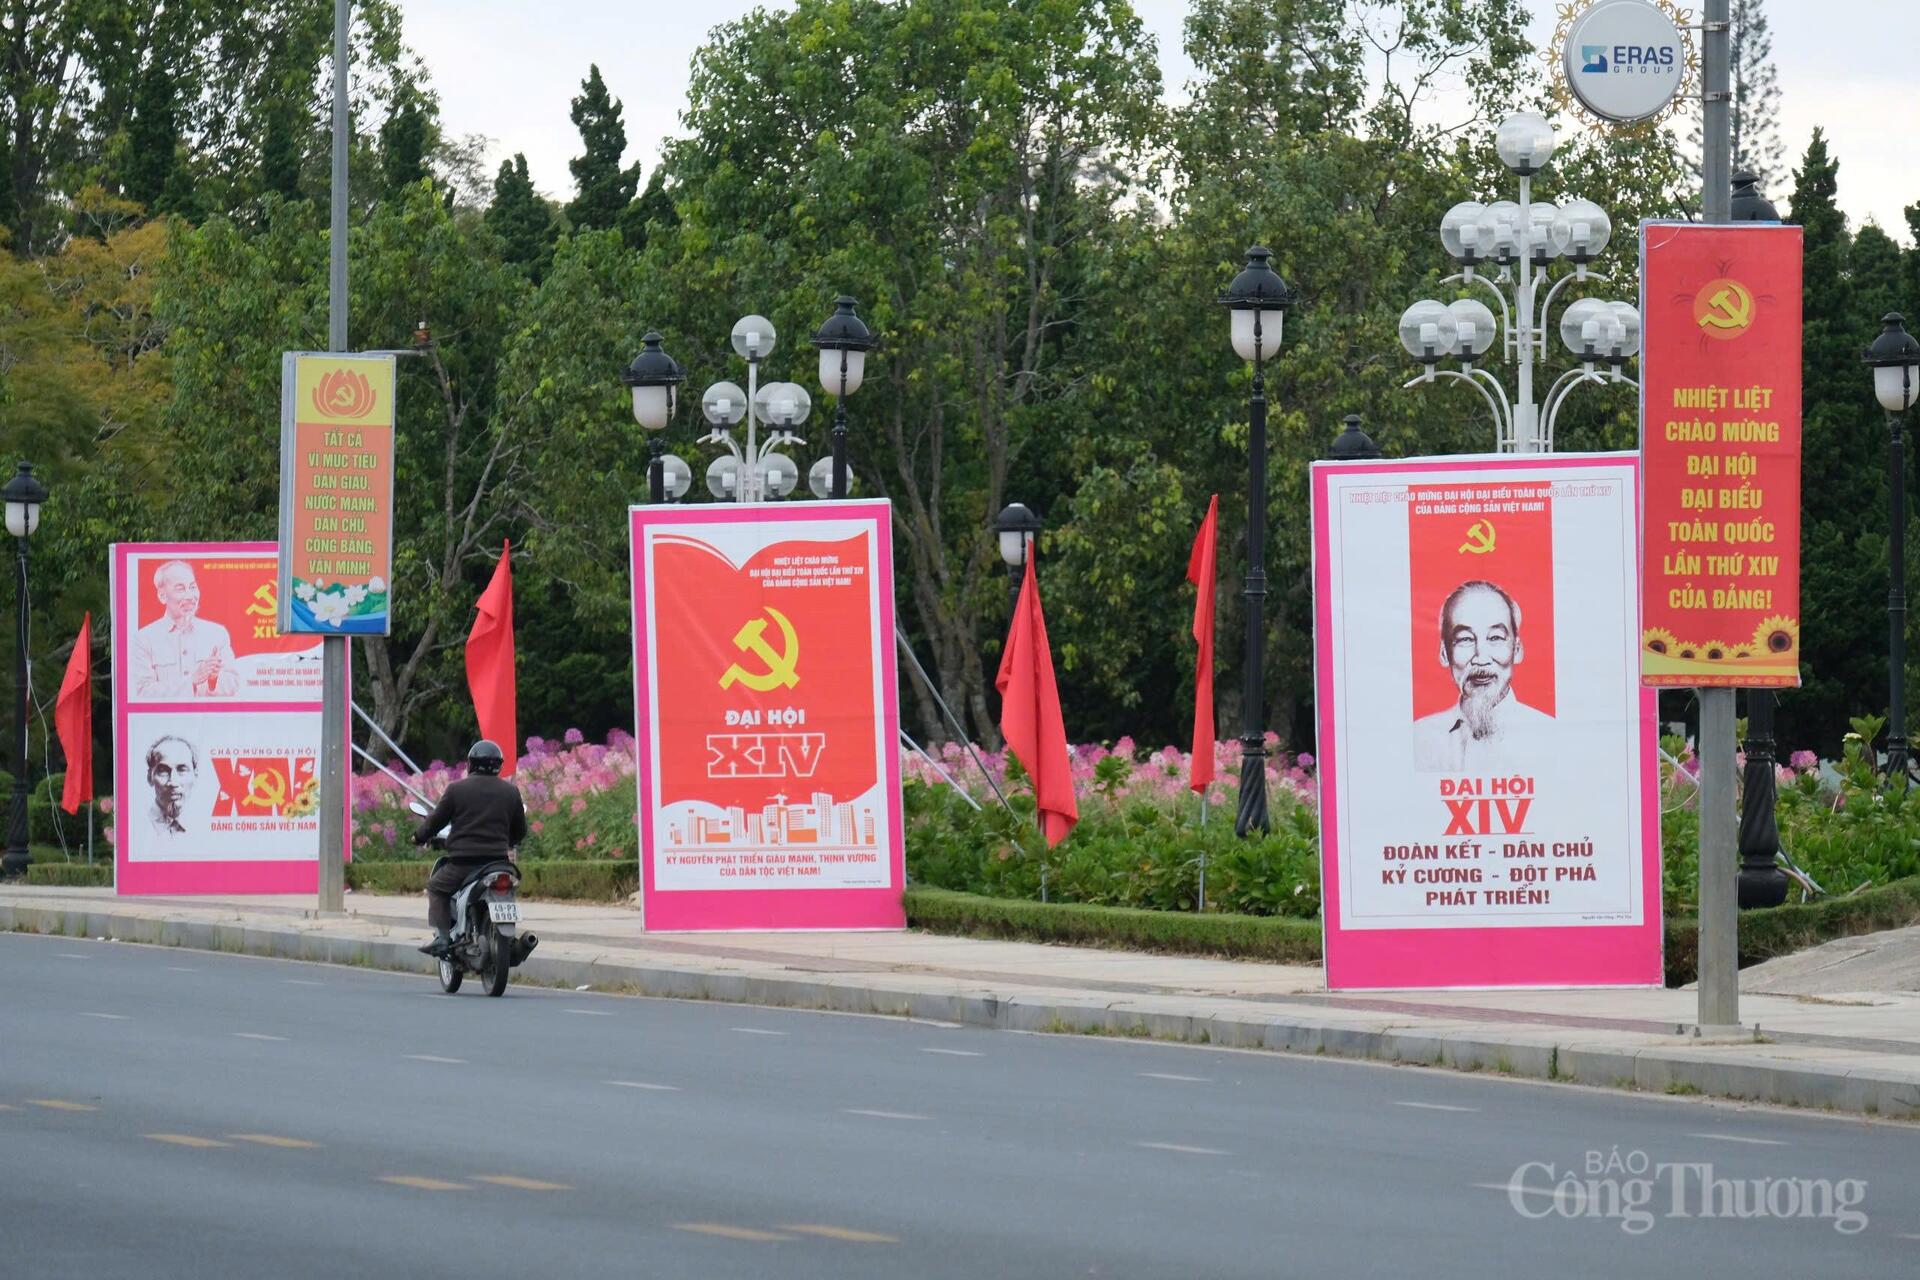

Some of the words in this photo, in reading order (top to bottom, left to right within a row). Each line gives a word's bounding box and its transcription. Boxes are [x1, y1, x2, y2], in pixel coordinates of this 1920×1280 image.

[1613, 46, 1673, 64] ERAS
[1613, 66, 1673, 74] GROUP
[1673, 384, 1729, 413] NHIỆT
[1734, 384, 1773, 413] LIỆT
[323, 429, 344, 447] TẤT
[347, 429, 362, 448] CẢ
[1665, 417, 1717, 441] CHÀO
[1722, 417, 1780, 442] MỪNG
[308, 450, 319, 467] VÌ
[323, 453, 348, 471] MỤC
[352, 451, 377, 469] TIÊU
[1687, 455, 1719, 480] ĐẠI
[1725, 451, 1757, 480] HỘI
[313, 473, 337, 489] DÂN
[305, 493, 336, 510] NƯỚC
[1350, 491, 1372, 504] NHIỆT
[1374, 490, 1393, 504] LIỆT
[1417, 488, 1442, 501] MỪNG
[1444, 490, 1459, 503] ĐẠI
[1460, 487, 1475, 502] HỘI
[1476, 489, 1491, 501] ĐẠI
[1492, 485, 1511, 499] BIỂU
[1513, 487, 1535, 499] TOÀN
[1537, 485, 1560, 499] QUỐC
[1598, 486, 1614, 497] XIV
[1681, 488, 1713, 513] ĐẠI
[1719, 480, 1762, 509] BIỂU
[1415, 501, 1432, 514] CỦA
[1434, 501, 1457, 514] ĐẢNG
[1459, 502, 1481, 515] CỘNG
[1483, 499, 1501, 513] SẢN
[1502, 501, 1520, 514] VIỆT
[1521, 502, 1545, 512] NAM!
[314, 515, 338, 531] DÂN
[1668, 517, 1719, 542] TOÀN
[1723, 515, 1775, 544] QUỐC
[305, 536, 337, 553] CÔNG
[335, 560, 370, 575] MINH!
[1663, 548, 1701, 575] LẦN
[1706, 551, 1745, 576] THỨ
[1748, 555, 1779, 576] XIV
[1669, 582, 1708, 609] CỦA
[1712, 582, 1772, 609] ĐẢNG!
[725, 709, 761, 729] ĐẠI
[767, 705, 805, 729] HỘI
[706, 732, 826, 778] XIV
[1440, 778, 1483, 799] ĐẠI
[1491, 774, 1534, 798] HỘI
[211, 820, 233, 831] ĐẢNG
[235, 820, 257, 832] CỘNG
[259, 820, 277, 831] SẢN
[278, 820, 295, 832] VIỆT
[297, 821, 317, 831] NAM
[1444, 798, 1532, 835] XIV
[666, 852, 677, 865] KỶ
[679, 854, 713, 865] NGUYÊN
[715, 854, 737, 864] PHÁT
[739, 851, 764, 864] TRIỂN
[766, 853, 786, 863] GIÀU
[788, 854, 817, 865] MẠNH,
[819, 854, 845, 864] THỊNH
[847, 853, 877, 864] VƯỢNG
[1383, 841, 1439, 860] ĐOÀN
[1445, 838, 1482, 859] KẾT
[1503, 840, 1545, 858] DÂN
[1552, 836, 1594, 858] CHỦ
[720, 863, 737, 876] CỦA
[739, 865, 757, 876] DÂN
[759, 865, 775, 877] TỘC
[777, 865, 795, 876] VIỆT
[797, 866, 821, 876] NAM!
[1382, 863, 1407, 884] KỶ
[1413, 867, 1482, 884] CƯƠNG
[1509, 864, 1549, 884] ĐỘT
[1555, 863, 1597, 882] PHÁ
[1426, 888, 1477, 906] PHÁT
[1483, 882, 1551, 905] TRIỂN!
